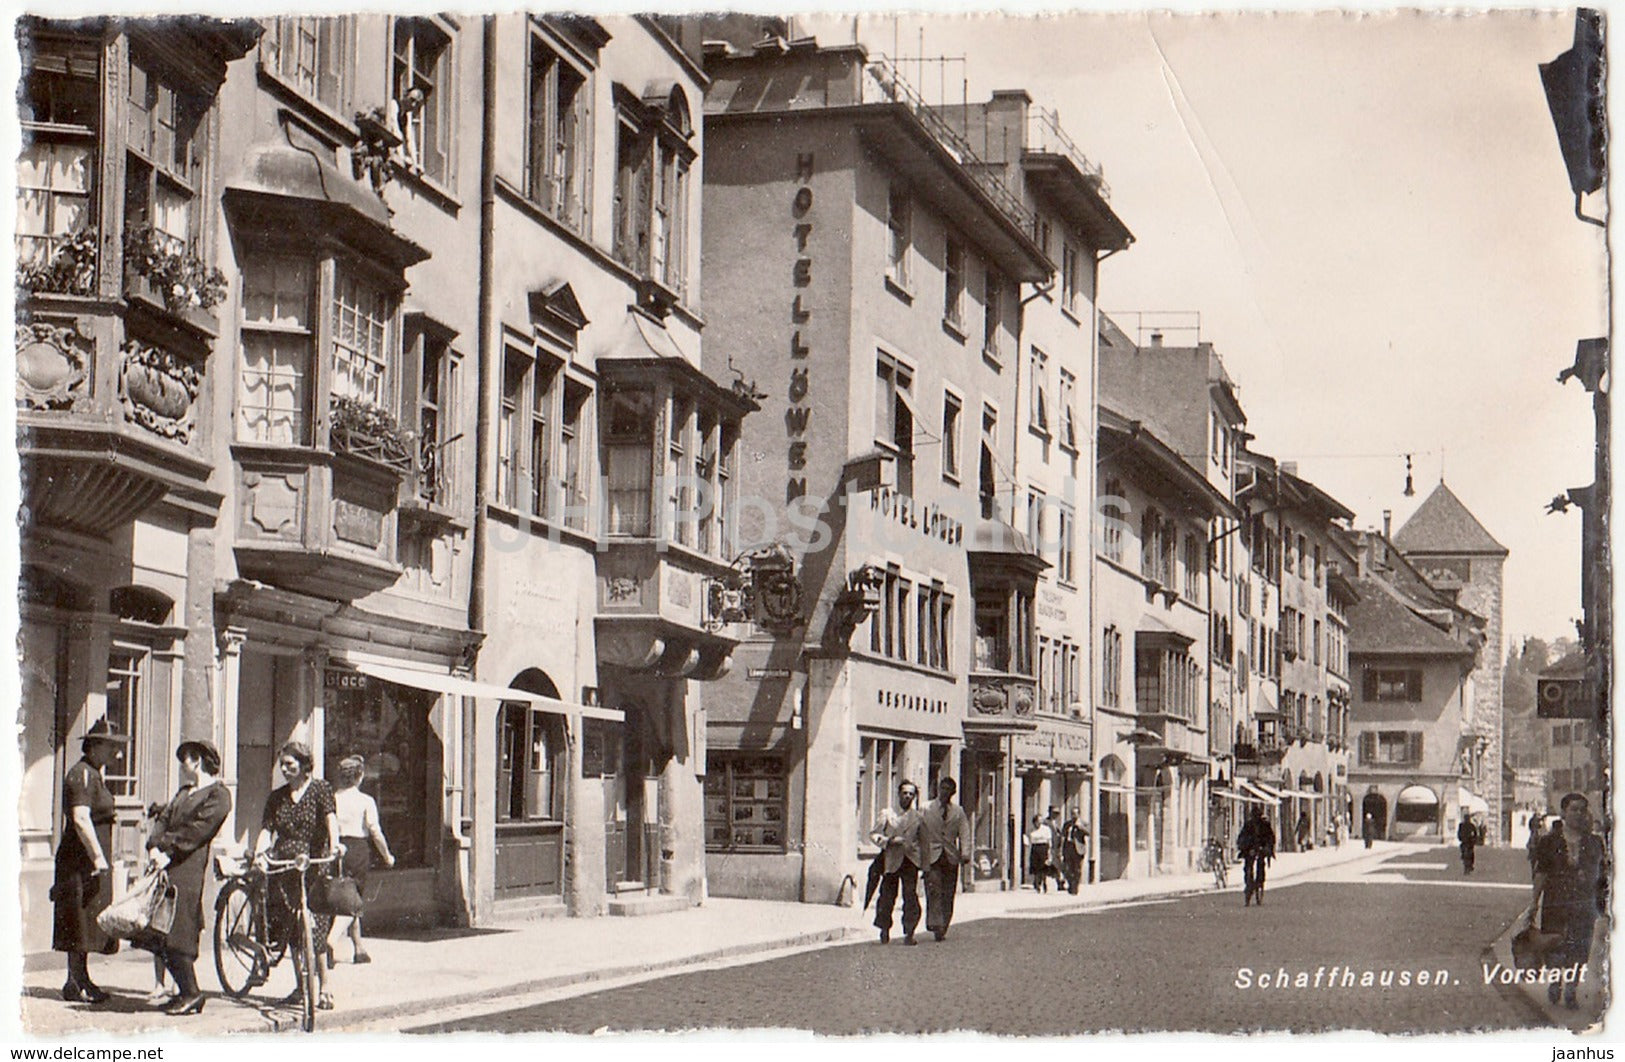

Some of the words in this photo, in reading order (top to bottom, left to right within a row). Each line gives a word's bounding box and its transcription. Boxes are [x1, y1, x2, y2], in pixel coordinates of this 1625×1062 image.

[791, 152, 814, 324] HOTEL
[784, 331, 811, 507] LÖWEN
[871, 487, 918, 530] HOTEL
[878, 689, 948, 714] RESTAURANT
